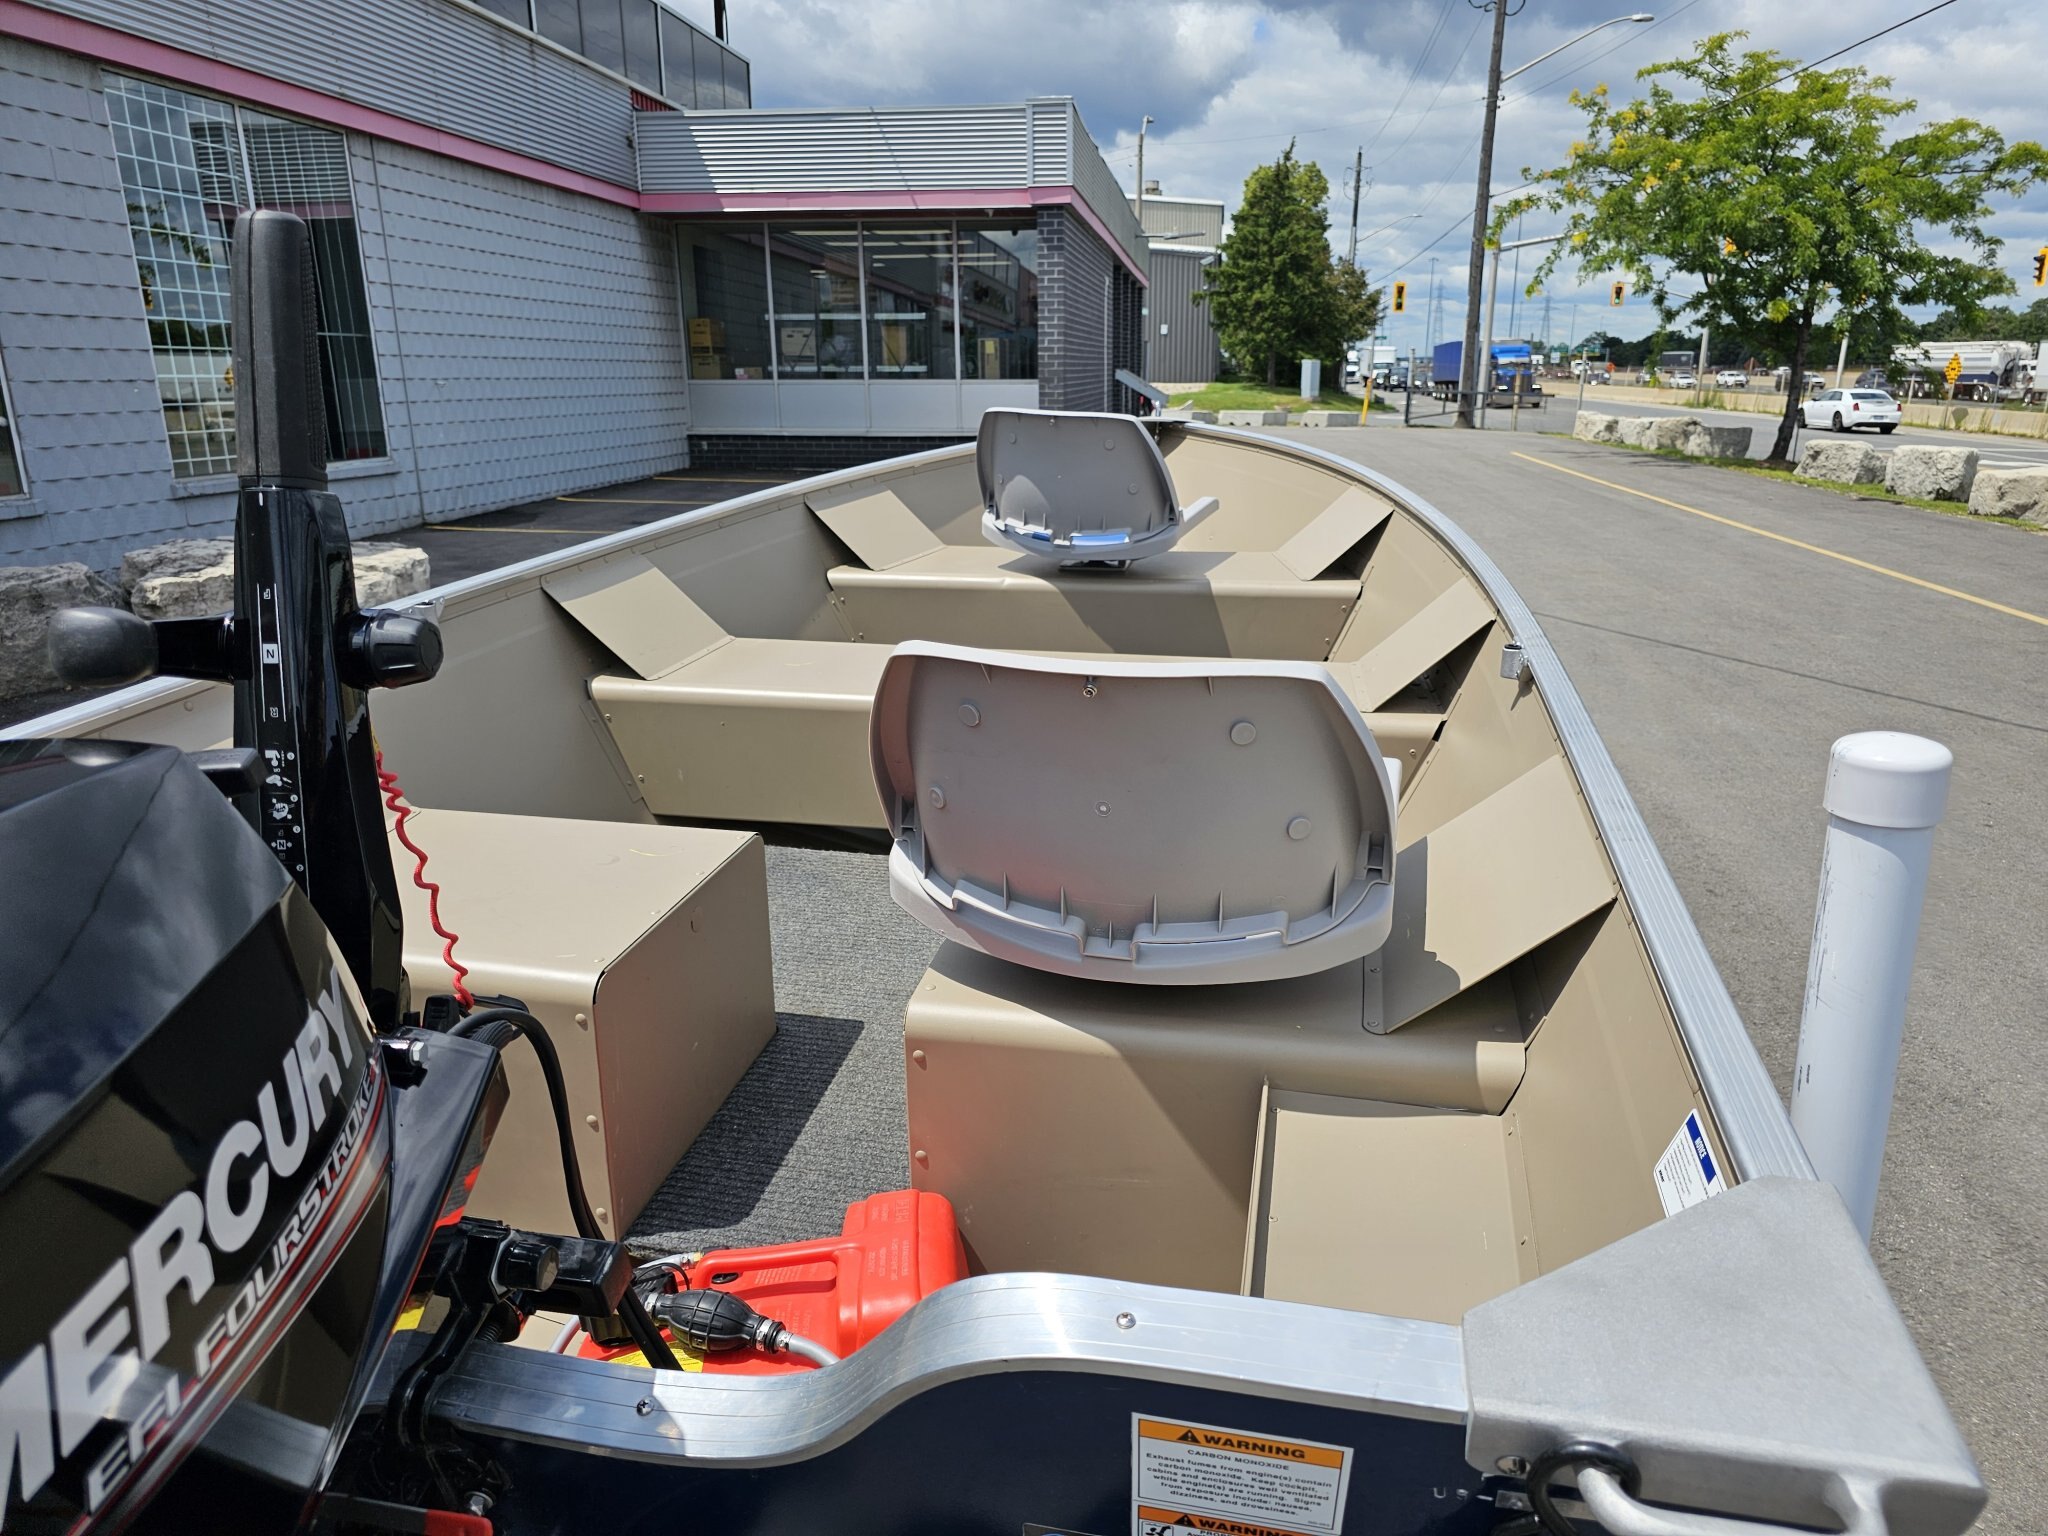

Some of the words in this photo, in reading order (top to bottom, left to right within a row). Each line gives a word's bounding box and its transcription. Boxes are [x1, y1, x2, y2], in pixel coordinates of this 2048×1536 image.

[87, 1373, 182, 1514] EFI
[193, 1066, 375, 1381] FOURSTROKE
[1187, 1448, 1231, 1461] CARBON
[1234, 1456, 1290, 1470] MONOXIDE
[1203, 1434, 1306, 1459] WARNING
[1145, 1452, 1184, 1463] Exhaust
[1187, 1459, 1217, 1468] fumes
[1220, 1465, 1242, 1473] from
[1245, 1469, 1292, 1482] engine(s)
[1294, 1477, 1332, 1488] contain
[1158, 1461, 1191, 1471] carbon
[1251, 1477, 1275, 1486] Keep
[1146, 1466, 1178, 1475] cabins
[1201, 1475, 1255, 1489] enclosures
[1280, 1489, 1329, 1501] ventilated
[1153, 1474, 1177, 1482] while
[1180, 1479, 1226, 1491] engine(s)
[1293, 1497, 1322, 1507] Signs
[1160, 1481, 1182, 1489] from
[1185, 1487, 1229, 1498] exposure
[1199, 1518, 1296, 1536] WARNIN
